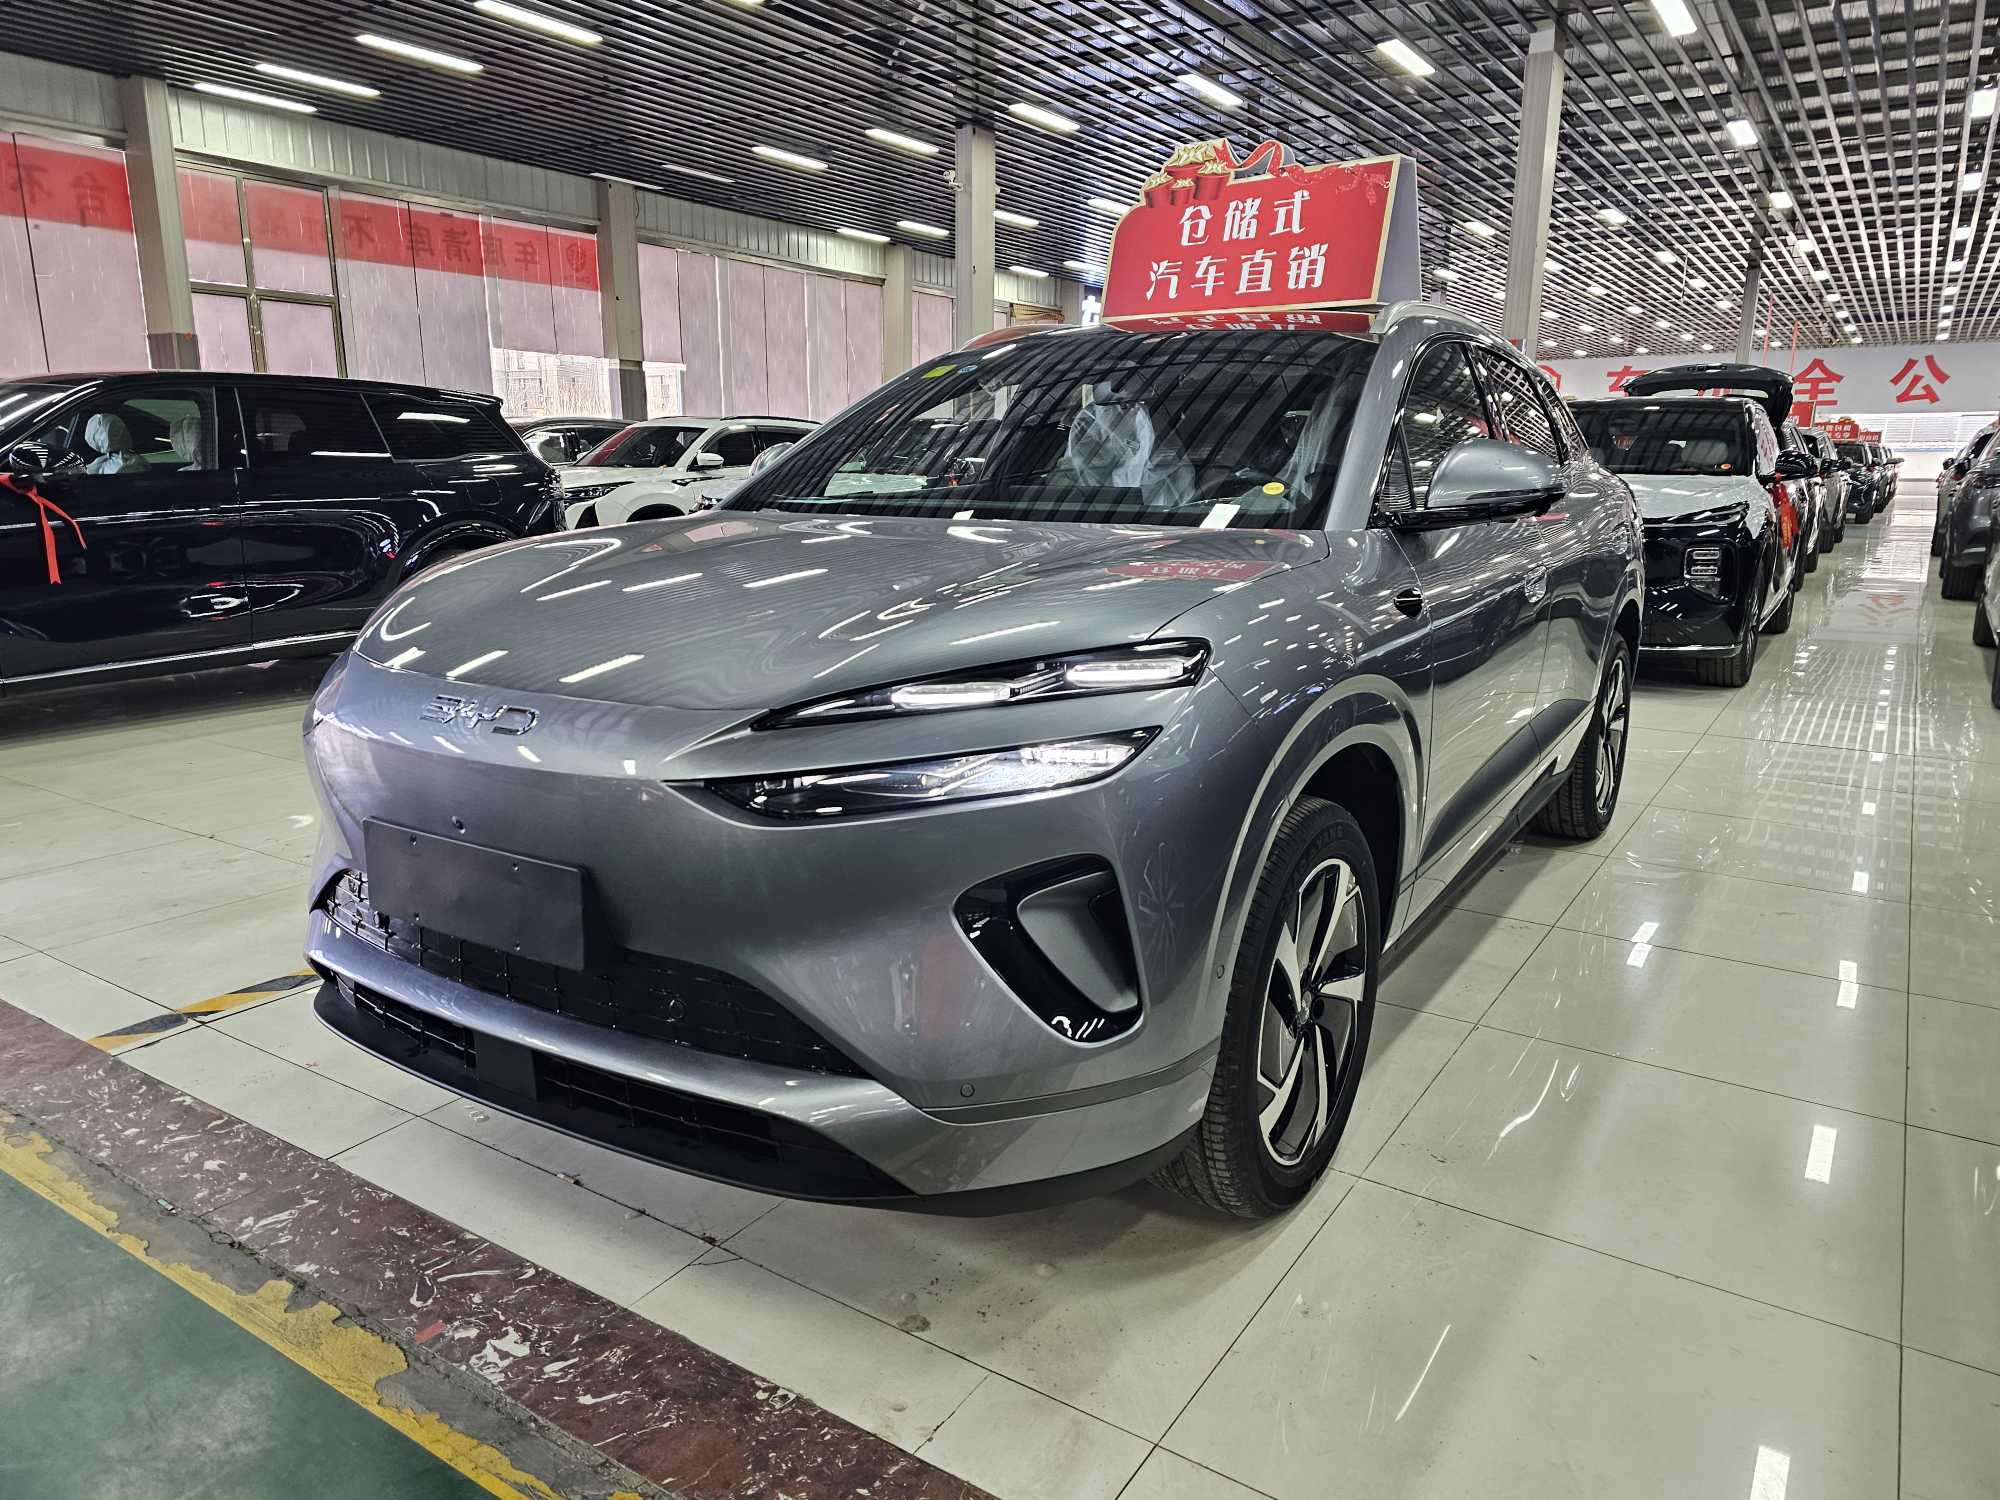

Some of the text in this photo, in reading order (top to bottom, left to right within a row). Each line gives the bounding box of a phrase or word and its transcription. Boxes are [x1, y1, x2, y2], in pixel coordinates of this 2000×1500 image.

[1179, 189, 1310, 246] 仓储式
[1146, 243, 1329, 301] 汽车直销
[419, 694, 539, 736] BYD
